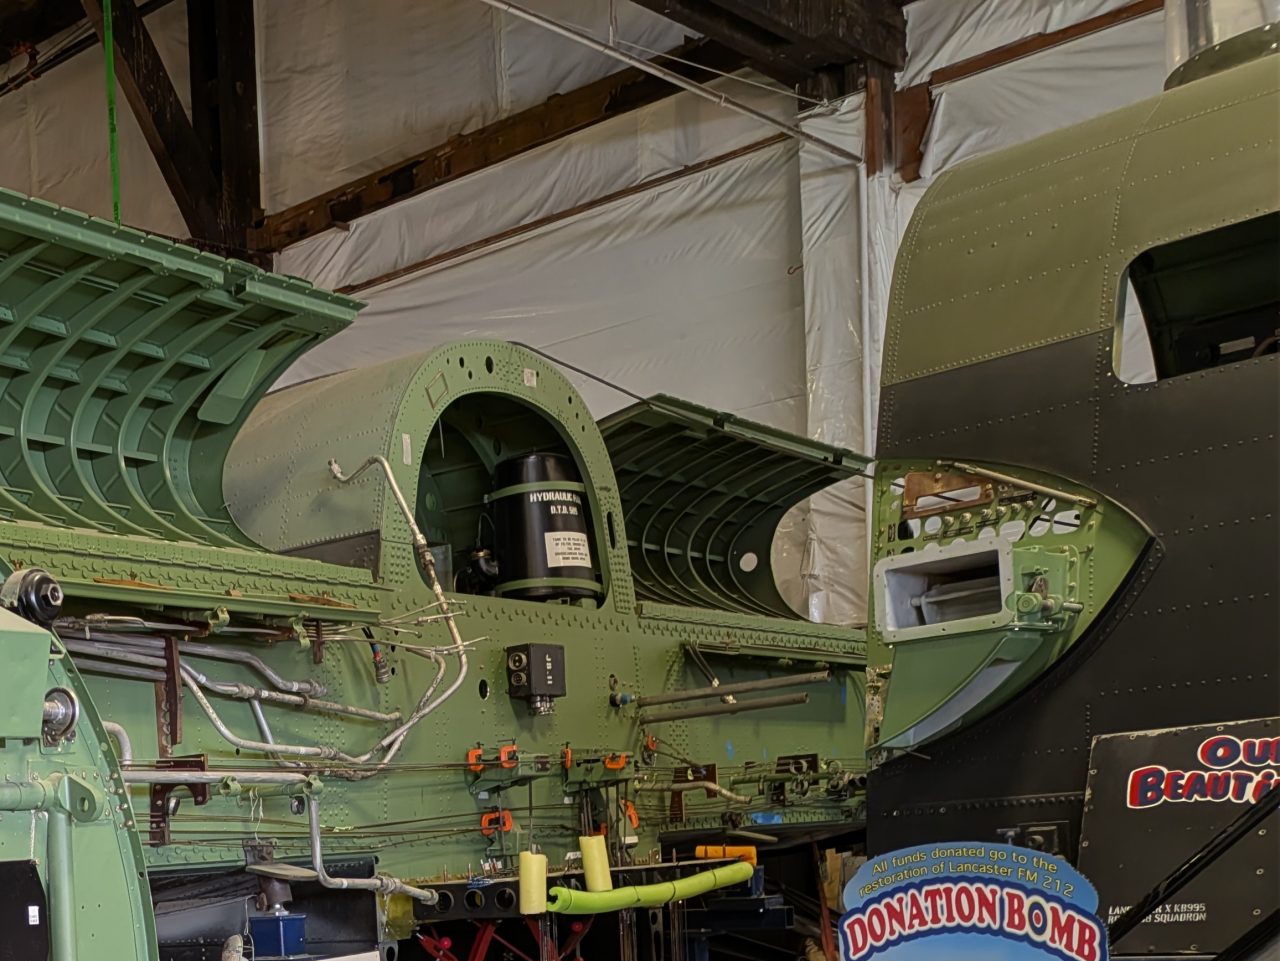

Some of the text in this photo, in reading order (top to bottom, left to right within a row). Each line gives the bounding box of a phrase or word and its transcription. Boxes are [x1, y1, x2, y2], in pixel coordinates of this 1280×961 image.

[872, 847, 1057, 876] All funds donated go to the
[859, 861, 1074, 897] restoration of Lancaster FM 212
[846, 884, 999, 958] DONATION
[1154, 912, 1207, 923] SQUADRON
[1165, 904, 1172, 913] X
[1173, 902, 1206, 913] KB995
